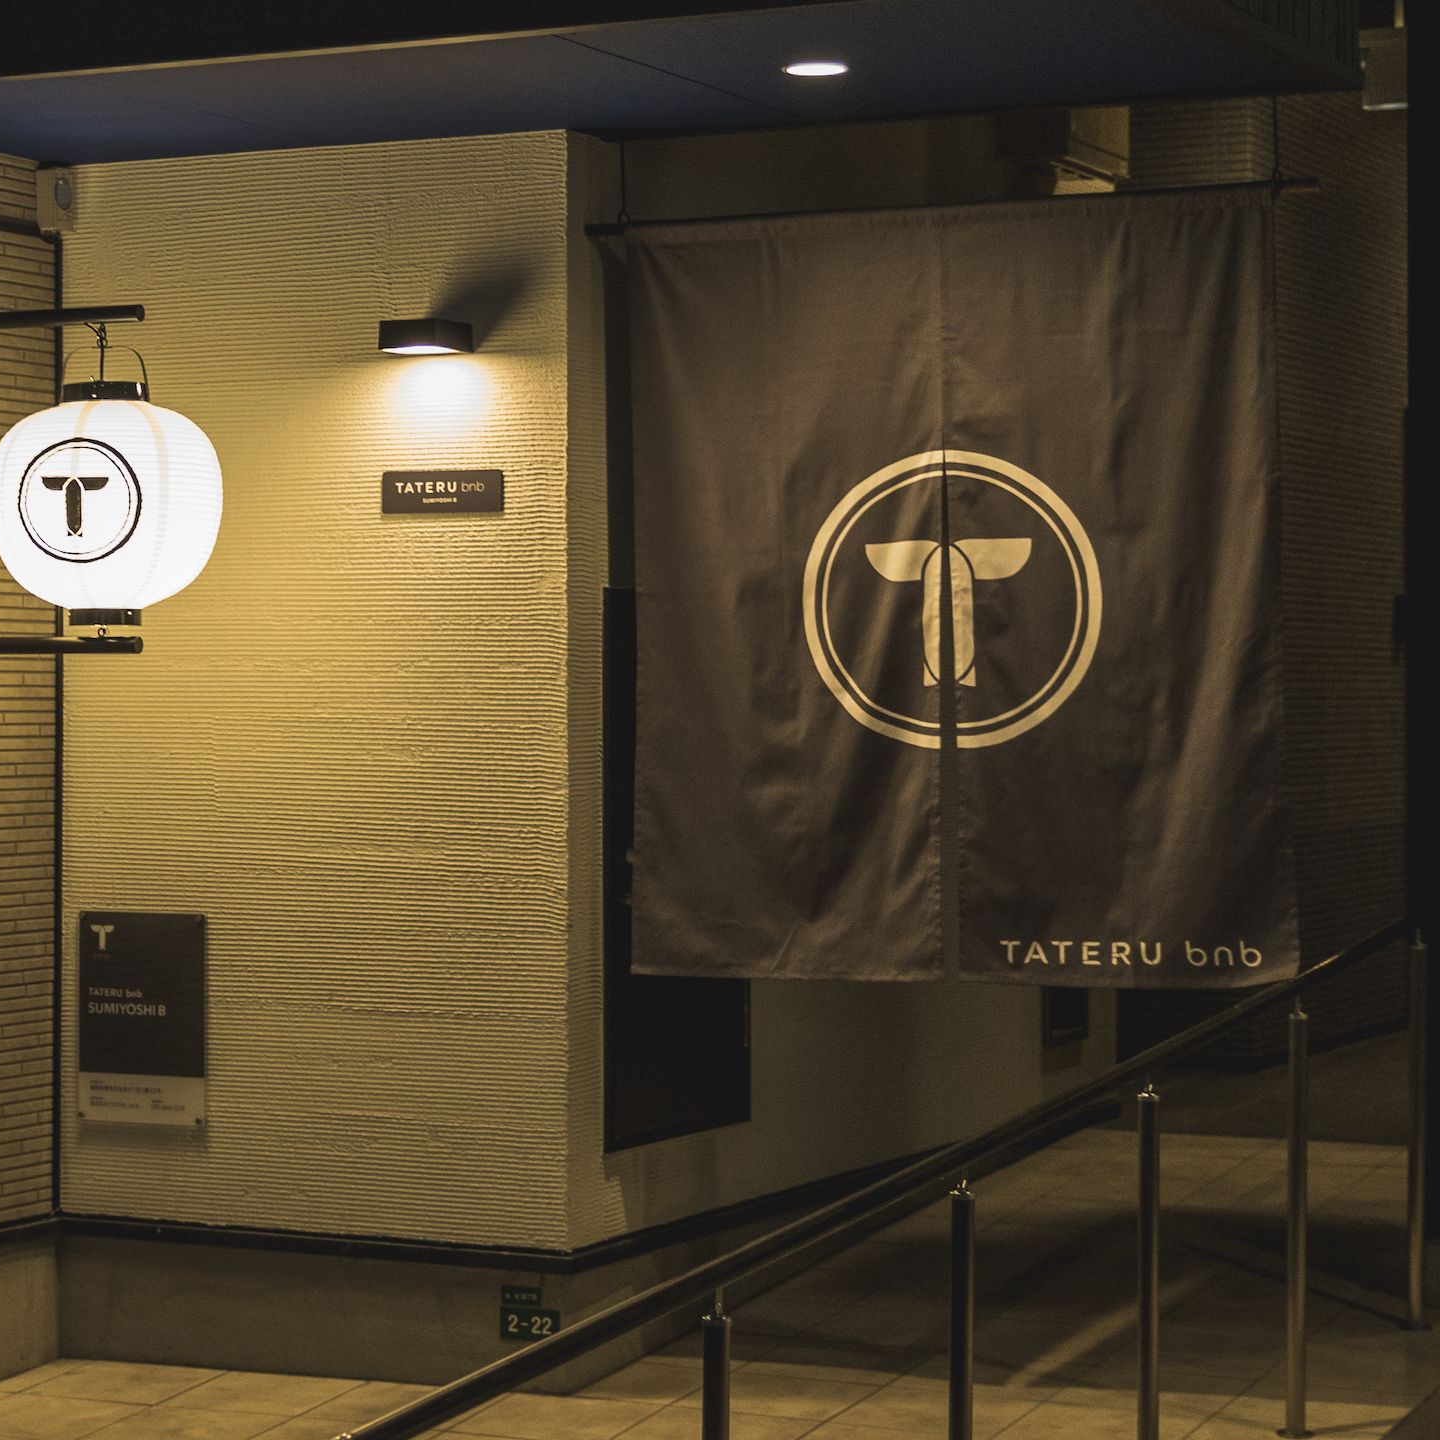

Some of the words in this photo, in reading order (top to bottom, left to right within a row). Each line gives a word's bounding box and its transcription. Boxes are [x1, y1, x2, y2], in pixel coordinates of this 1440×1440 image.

[395, 481, 457, 494] TATERU
[461, 482, 485, 492] bnb
[999, 940, 1161, 966] TATERU
[1185, 940, 1262, 967] bnb
[88, 987, 123, 997] TATERU
[125, 988, 143, 998] bnb
[88, 1002, 156, 1016] SUMIYOSHI
[158, 1005, 166, 1016] B
[508, 1314, 552, 1335] 2-22
